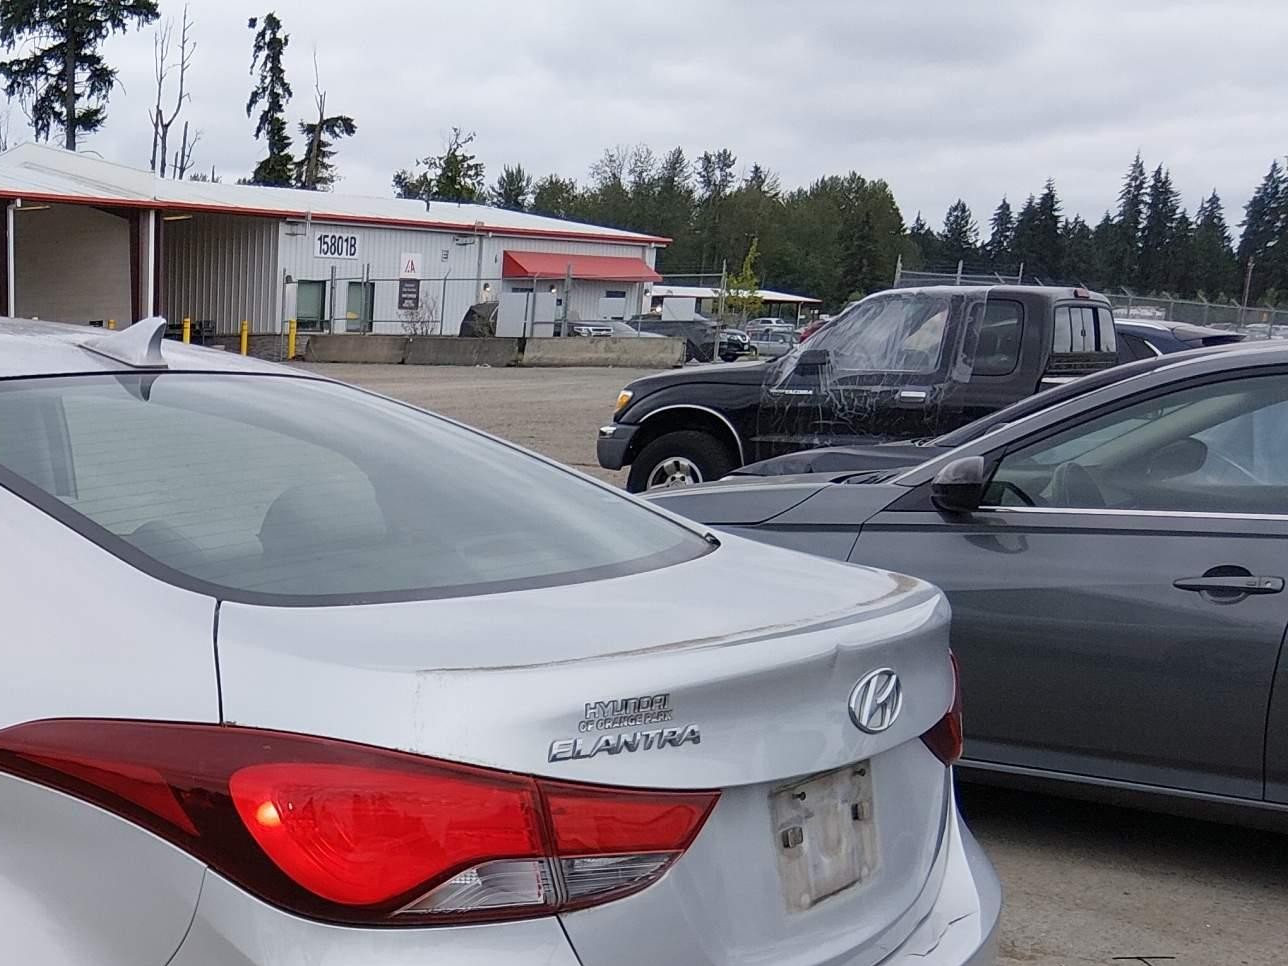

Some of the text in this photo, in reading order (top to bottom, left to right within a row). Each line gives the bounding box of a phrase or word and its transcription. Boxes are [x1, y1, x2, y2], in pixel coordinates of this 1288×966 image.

[317, 234, 357, 257] 15801B
[584, 693, 670, 719] HYUNDAI
[578, 709, 673, 733] OF ORANGE PARK
[547, 723, 701, 763] ELANTRA
